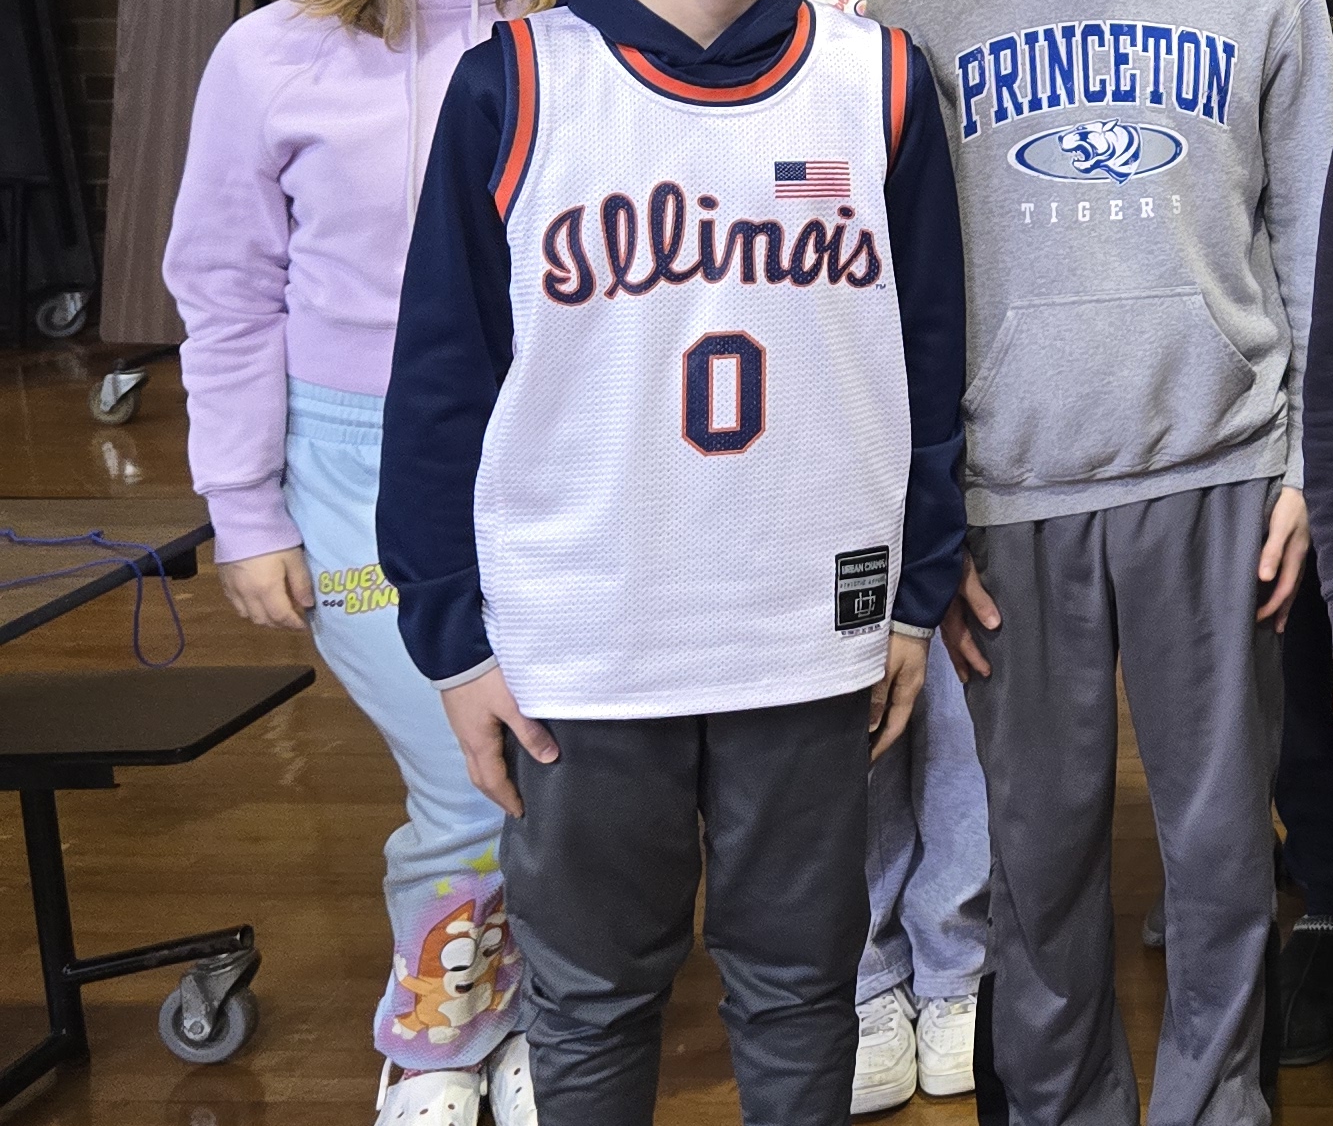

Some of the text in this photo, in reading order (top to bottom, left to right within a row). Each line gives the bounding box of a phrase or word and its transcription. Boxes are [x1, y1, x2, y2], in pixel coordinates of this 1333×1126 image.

[955, 19, 1238, 144] PRINCETON
[542, 180, 883, 307] Illinois
[1020, 195, 1182, 224] TIGERS
[681, 330, 767, 458] 0
